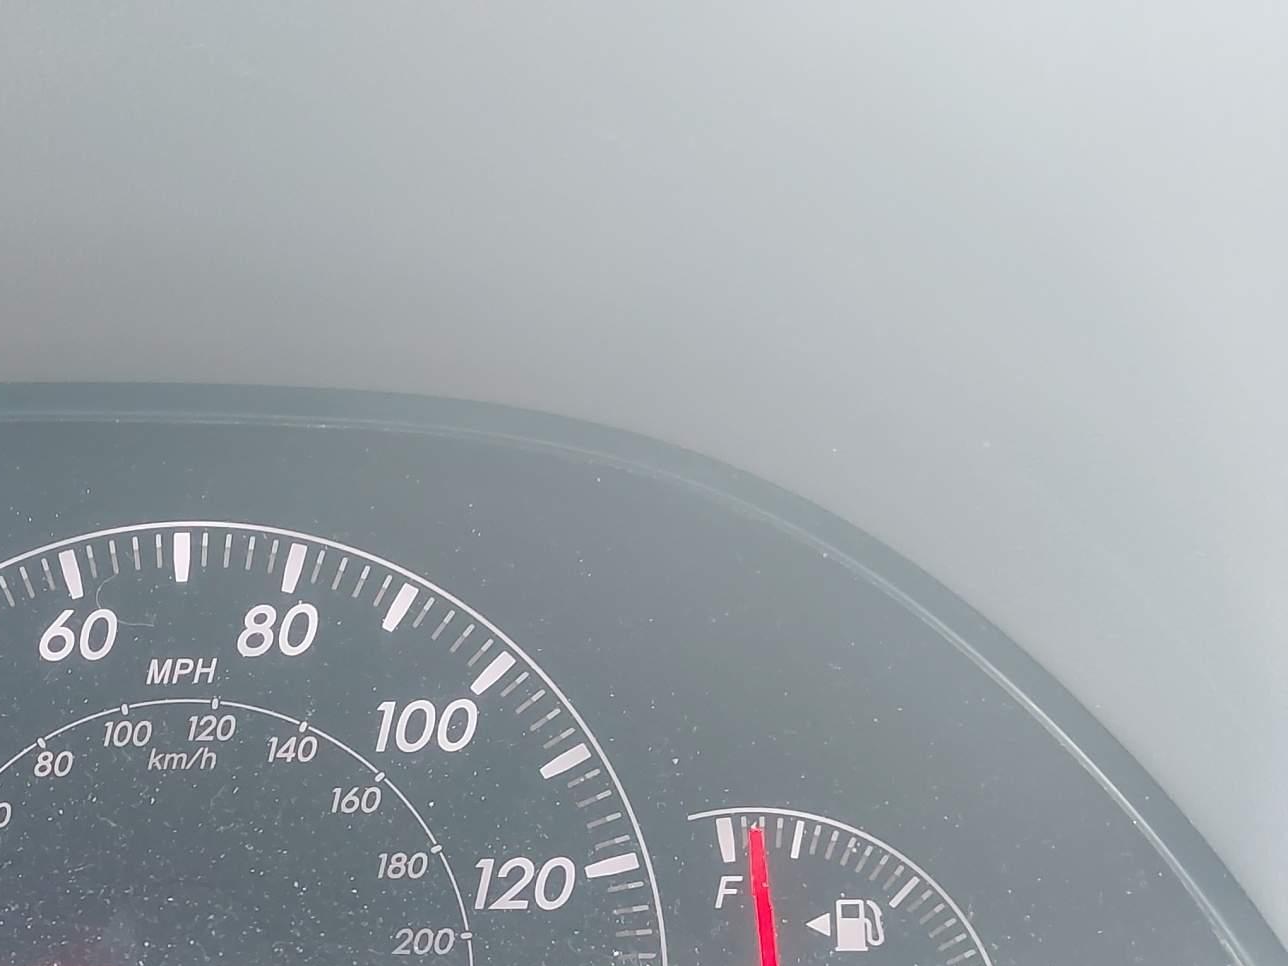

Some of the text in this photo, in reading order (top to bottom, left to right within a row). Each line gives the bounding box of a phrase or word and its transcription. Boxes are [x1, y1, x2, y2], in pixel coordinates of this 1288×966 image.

[38, 608, 118, 662] 60
[237, 603, 319, 656] 80
[146, 657, 218, 685] MPH
[103, 720, 153, 747] 100
[188, 714, 236, 741] 120
[375, 698, 480, 753] 100
[147, 746, 217, 771] km/h
[267, 735, 317, 763] 140
[33, 750, 74, 777] 80
[331, 786, 382, 814] 160
[377, 852, 428, 879] 180
[473, 857, 576, 911] 120
[715, 875, 744, 909] F
[392, 928, 455, 955] 200
